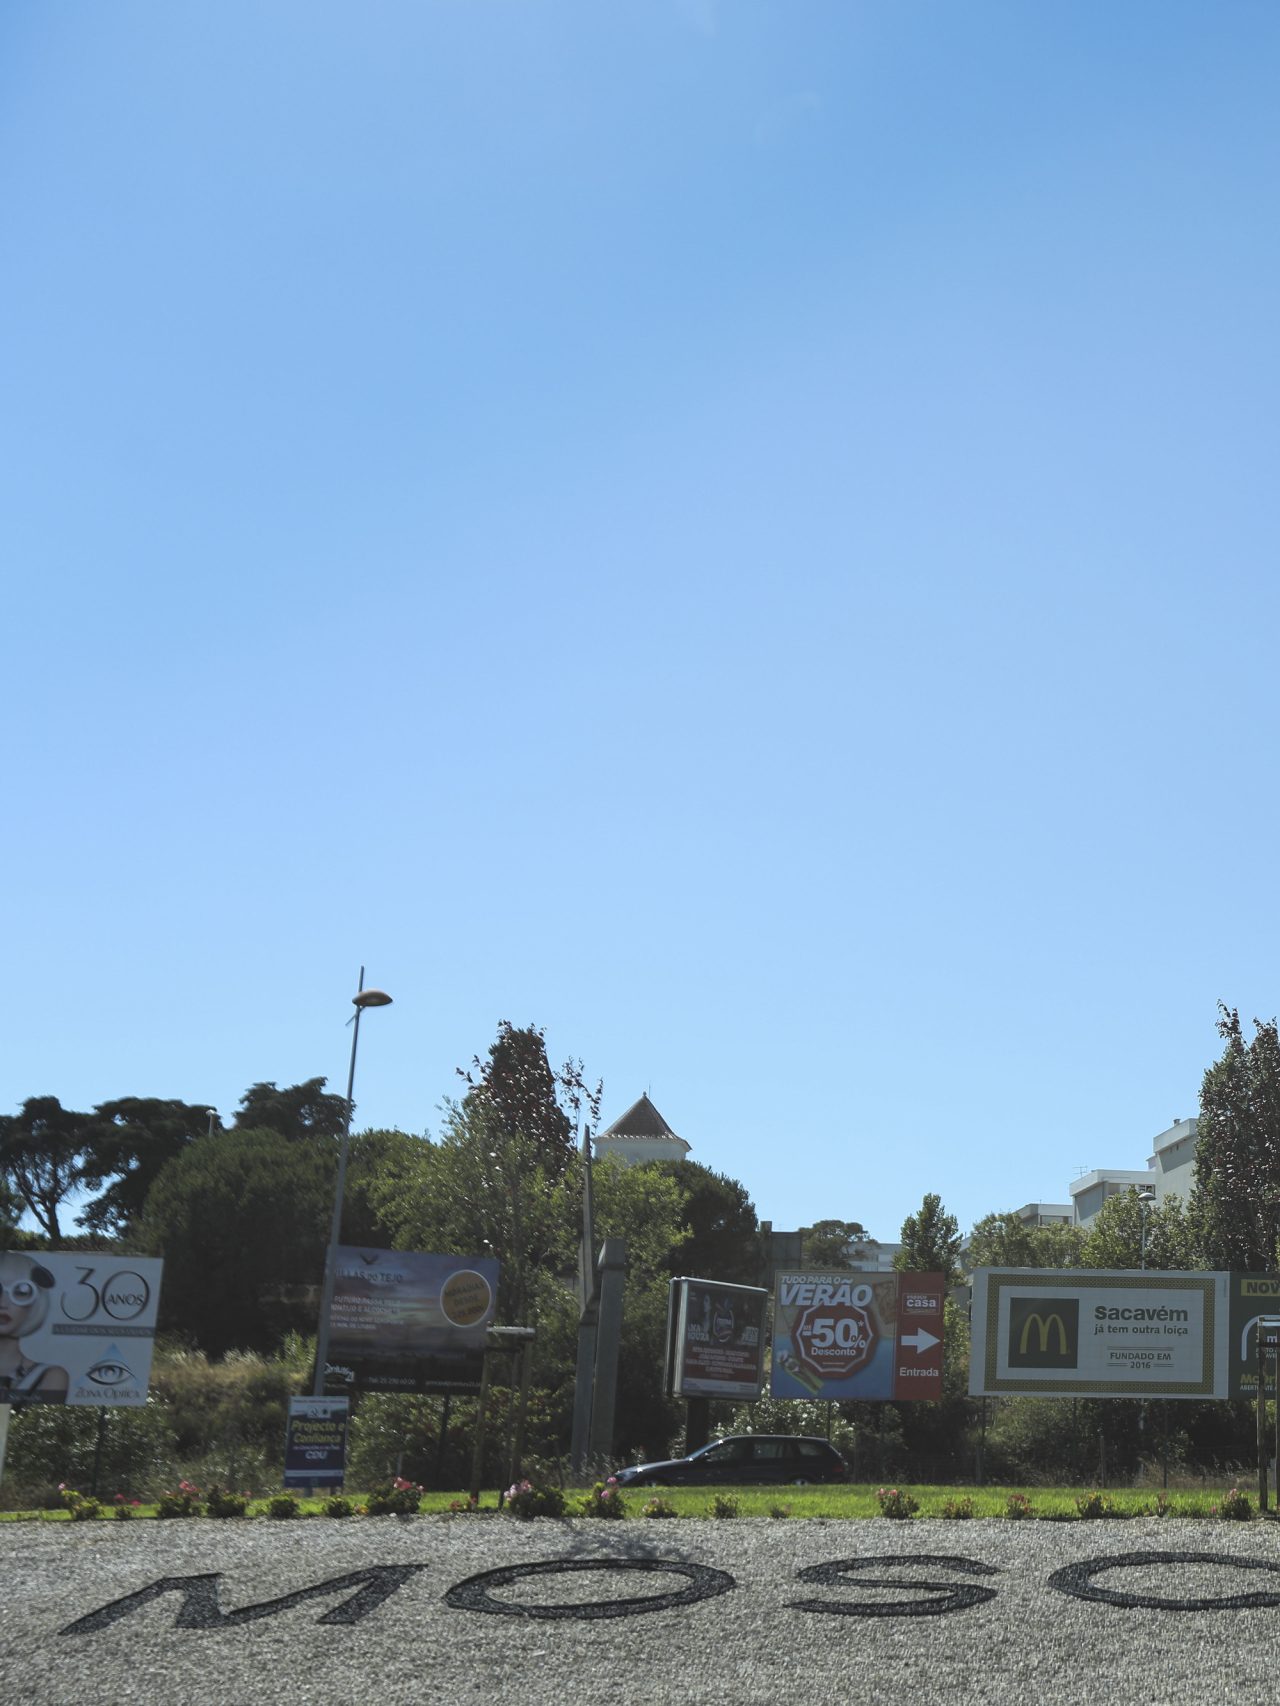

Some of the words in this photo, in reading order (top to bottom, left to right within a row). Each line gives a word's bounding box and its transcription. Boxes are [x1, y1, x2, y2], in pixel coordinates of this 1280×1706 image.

[781, 1275, 807, 1284] TUDO
[808, 1276, 833, 1284] PARA
[834, 1276, 841, 1284] O
[60, 1265, 150, 1322] 30
[780, 1278, 873, 1307] VERÃO
[106, 1293, 145, 1306] ANOS
[906, 1299, 937, 1308] casa
[1094, 1305, 1189, 1322] Sacavém
[1094, 1324, 1104, 1336] já
[1107, 1325, 1129, 1334] tem
[1132, 1326, 1160, 1335] outra
[1163, 1325, 1188, 1336] loiça
[811, 1347, 856, 1357] Desconto
[1110, 1352, 1154, 1361] FUNDADO
[1157, 1353, 1171, 1361] EM
[1130, 1361, 1151, 1369] 2016
[900, 1367, 939, 1377] Entrada
[305, 1451, 328, 1459] CDU
